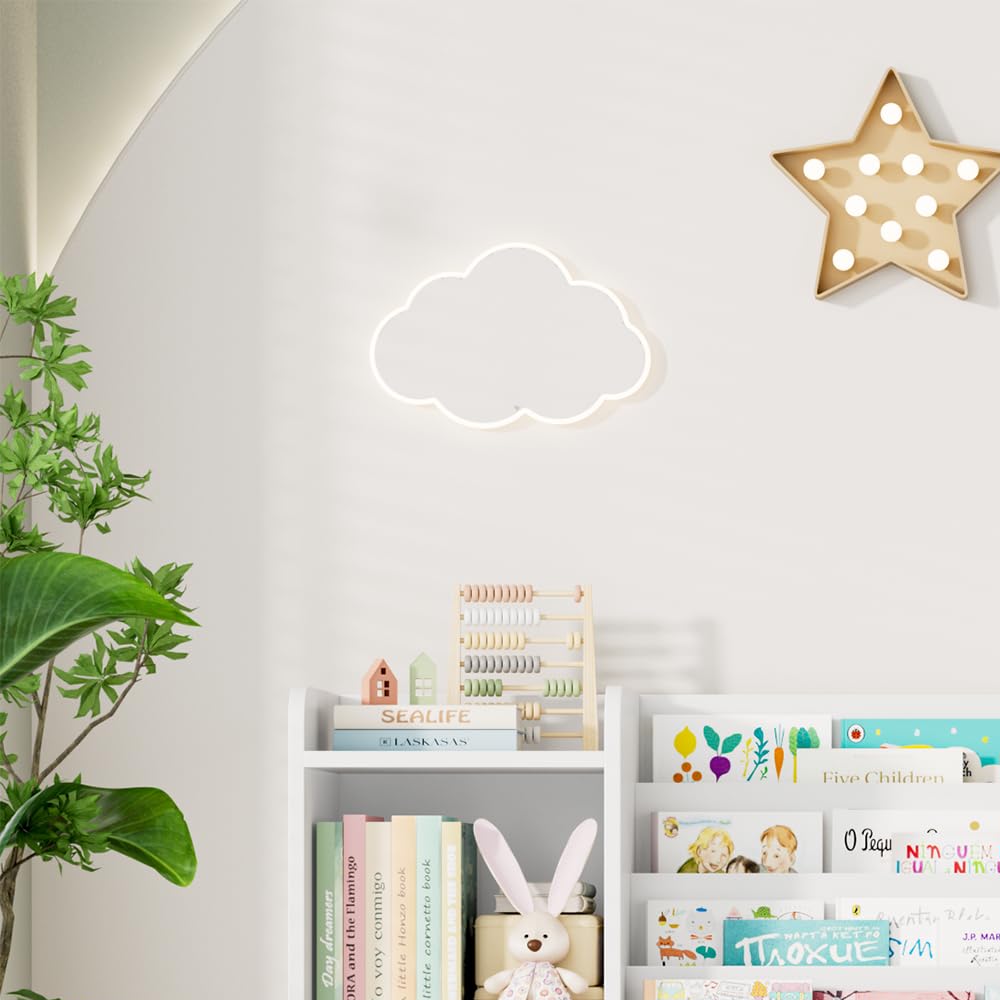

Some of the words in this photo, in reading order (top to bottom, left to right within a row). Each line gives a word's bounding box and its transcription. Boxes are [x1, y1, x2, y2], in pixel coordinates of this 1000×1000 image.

[381, 709, 471, 723] SEALIFE
[394, 737, 467, 746] LASKASAS
[823, 770, 859, 783] Five
[864, 769, 944, 783] Children
[844, 828, 857, 851] O
[862, 828, 892, 857] Pequ
[346, 855, 357, 915] Flamingo
[397, 867, 407, 898] book
[422, 859, 431, 890] book
[320, 890, 335, 952] dreamers
[371, 872, 386, 940] conmigo
[346, 918, 356, 939] the
[398, 904, 407, 946] Honzo
[423, 895, 431, 957] cornetto
[962, 933, 977, 941] J.P.
[346, 943, 356, 970] and
[374, 947, 385, 978] voy
[889, 937, 933, 960] SIM
[322, 956, 337, 989] Day
[397, 953, 407, 989] little
[422, 962, 431, 999] little
